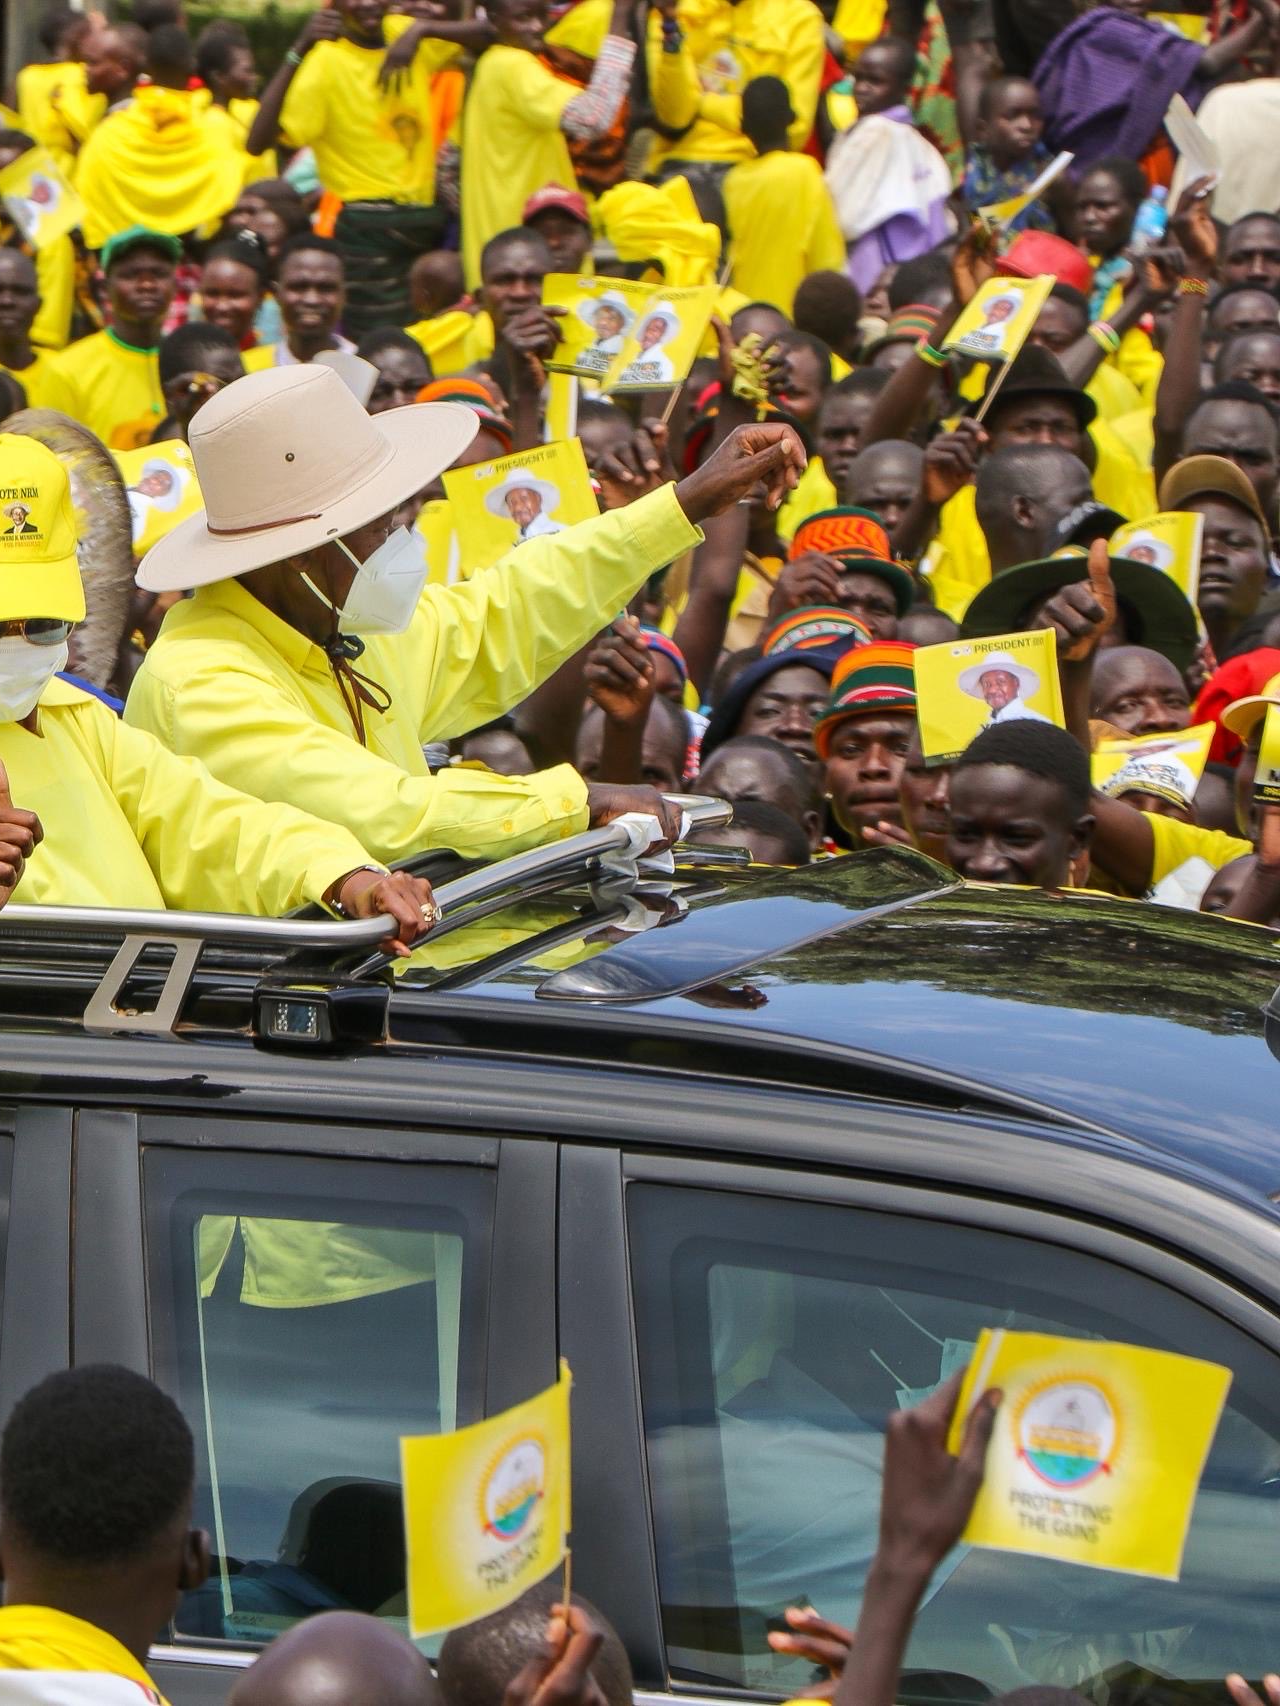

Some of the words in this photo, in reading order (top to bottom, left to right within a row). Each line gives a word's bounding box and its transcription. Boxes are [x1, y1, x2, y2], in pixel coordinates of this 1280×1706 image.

[495, 452, 545, 473] PRESIDENT
[20, 487, 39, 499] NRM
[973, 638, 1032, 654] PRESIDENT
[1008, 1487, 1113, 1525] PROTECTING
[1018, 1510, 1048, 1536] THE
